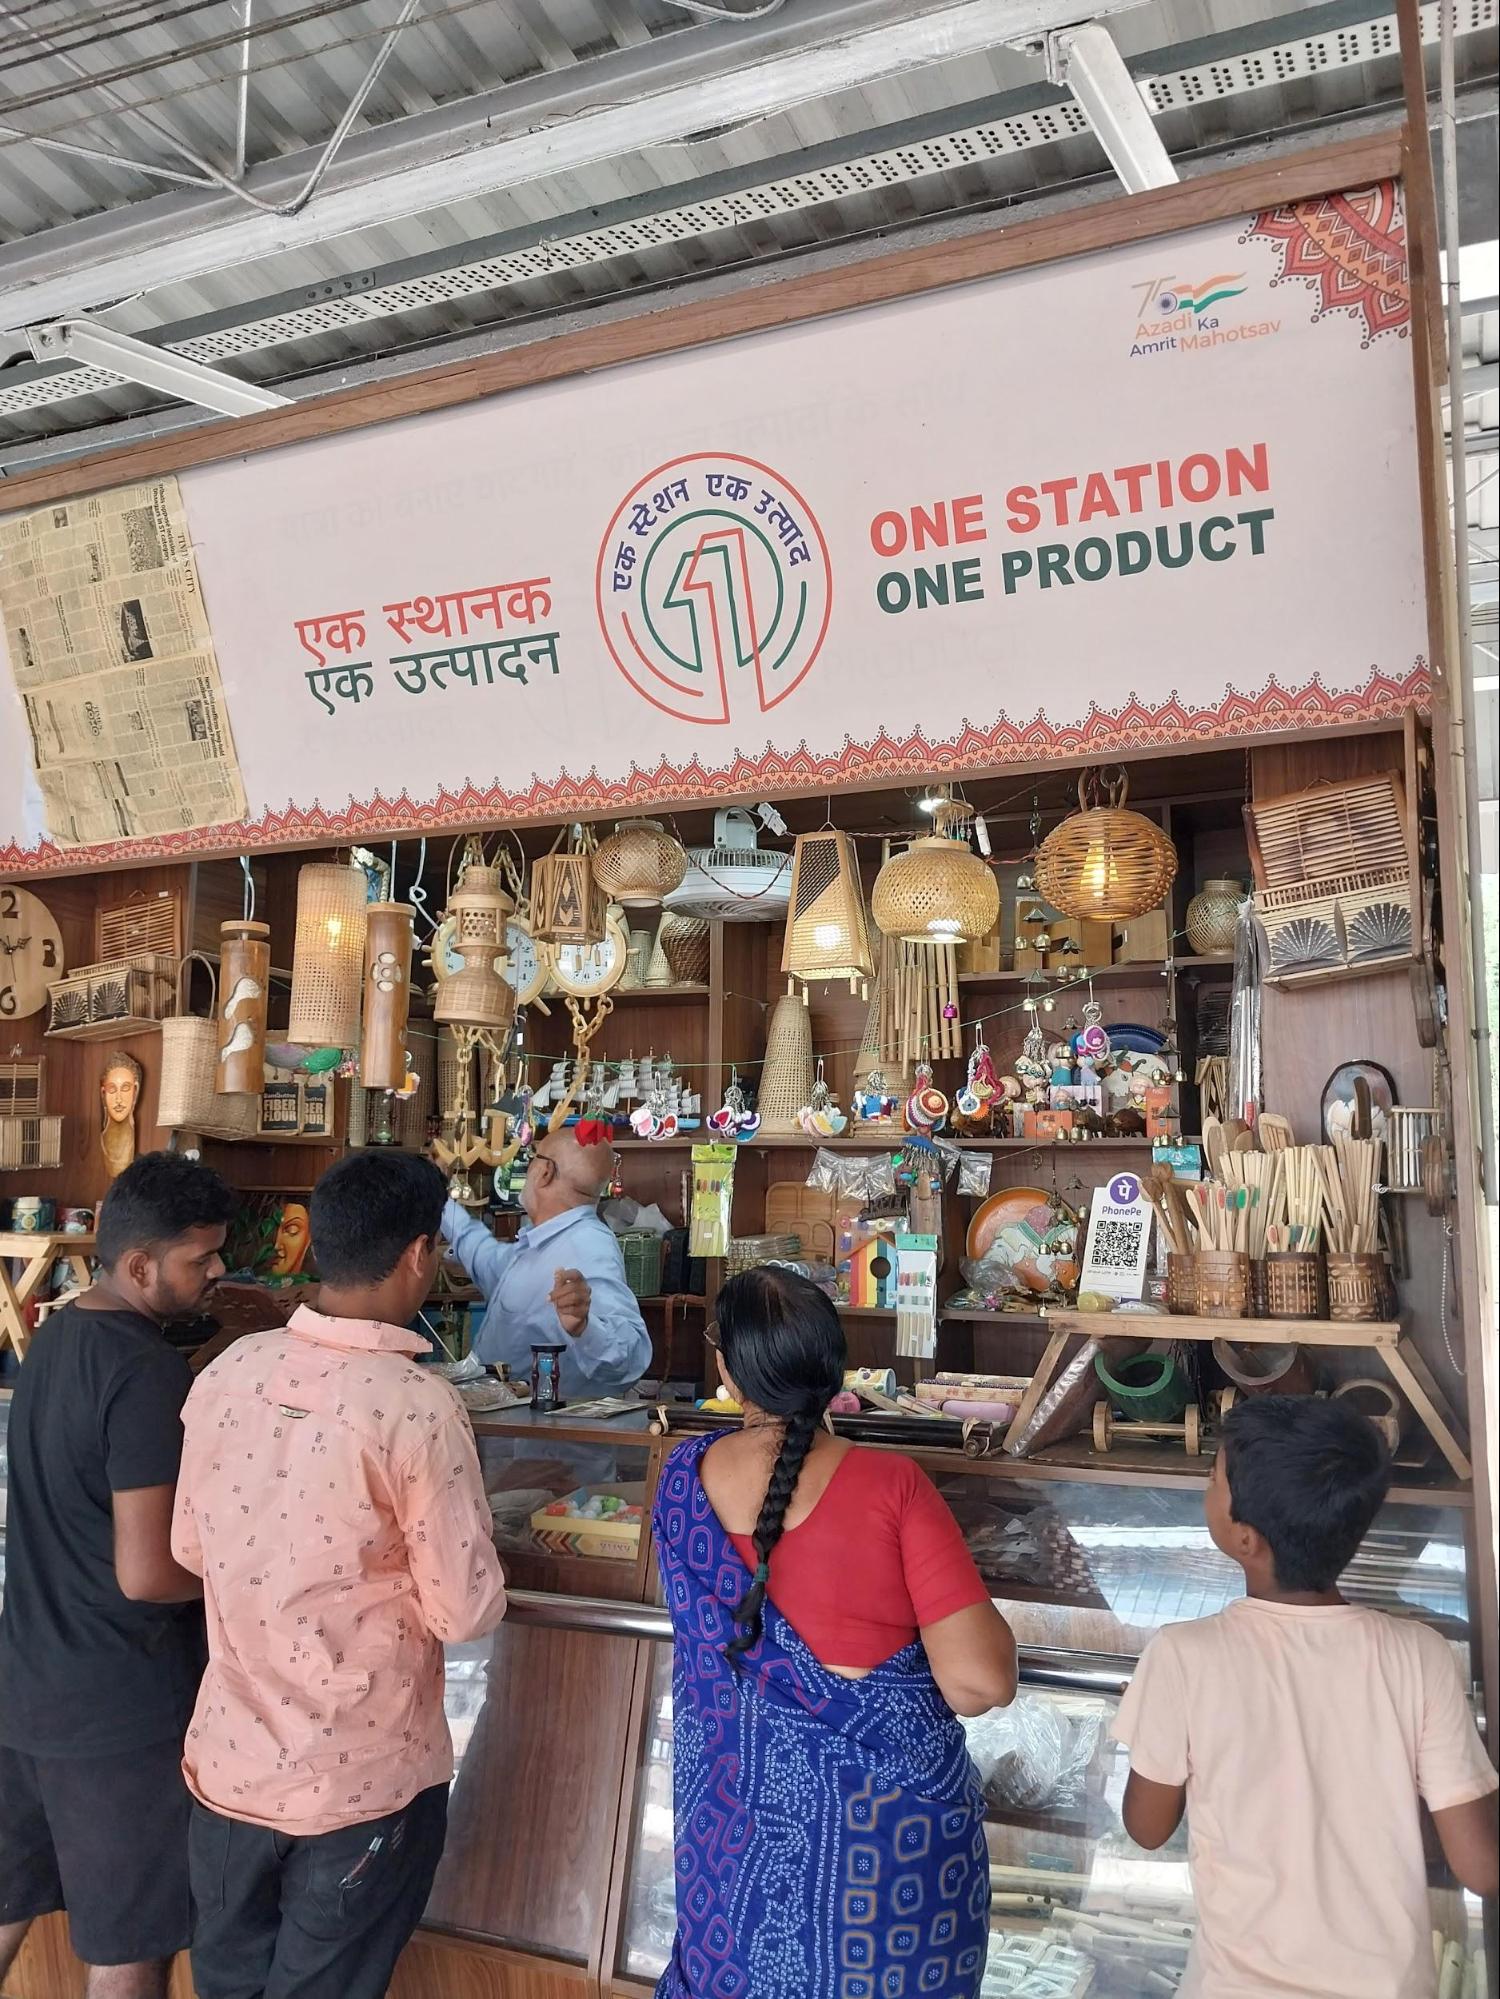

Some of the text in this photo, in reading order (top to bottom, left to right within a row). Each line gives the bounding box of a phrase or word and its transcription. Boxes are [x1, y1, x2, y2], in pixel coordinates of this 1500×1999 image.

[1130, 320, 1281, 357] Amrit Mahotsav
[1136, 313, 1219, 340] Azadi Ka
[869, 443, 1270, 557] ONE STATION
[613, 541, 637, 592] एक
[628, 478, 690, 536] स्टेशन
[705, 474, 752, 501] एक
[753, 489, 811, 566] उत्पाद
[876, 508, 1275, 614] ONE PRODUCT
[294, 576, 552, 667] एक स्थानक
[305, 632, 560, 715] एक उत्पादन
[1, 889, 19, 919] 2
[42, 938, 56, 967] 3
[0, 985, 16, 1015] 6
[263, 1099, 296, 1111] FIBER
[263, 1111, 297, 1122] FLOUR
[1118, 1179, 1132, 1201] पे
[1102, 1206, 1142, 1216] PhonePe
